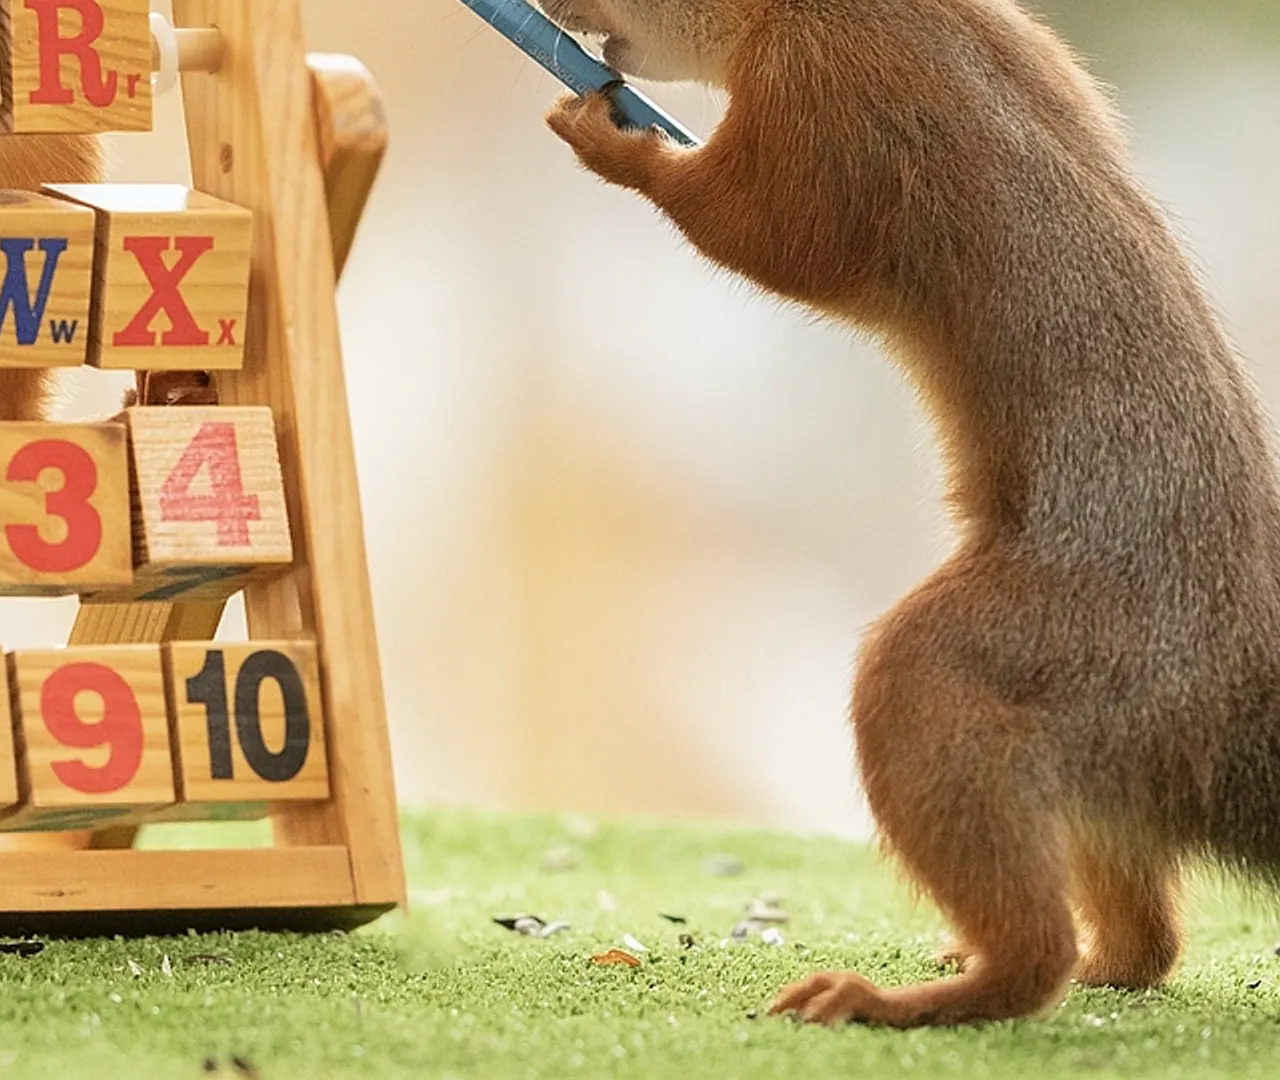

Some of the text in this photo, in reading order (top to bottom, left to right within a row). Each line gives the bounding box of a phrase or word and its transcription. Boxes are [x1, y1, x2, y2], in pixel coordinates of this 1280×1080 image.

[126, 72, 141, 98] r
[112, 236, 214, 347] X
[4, 438, 102, 573] 3
[159, 421, 261, 548] 4
[41, 661, 144, 795] 9
[186, 649, 311, 782] 10
